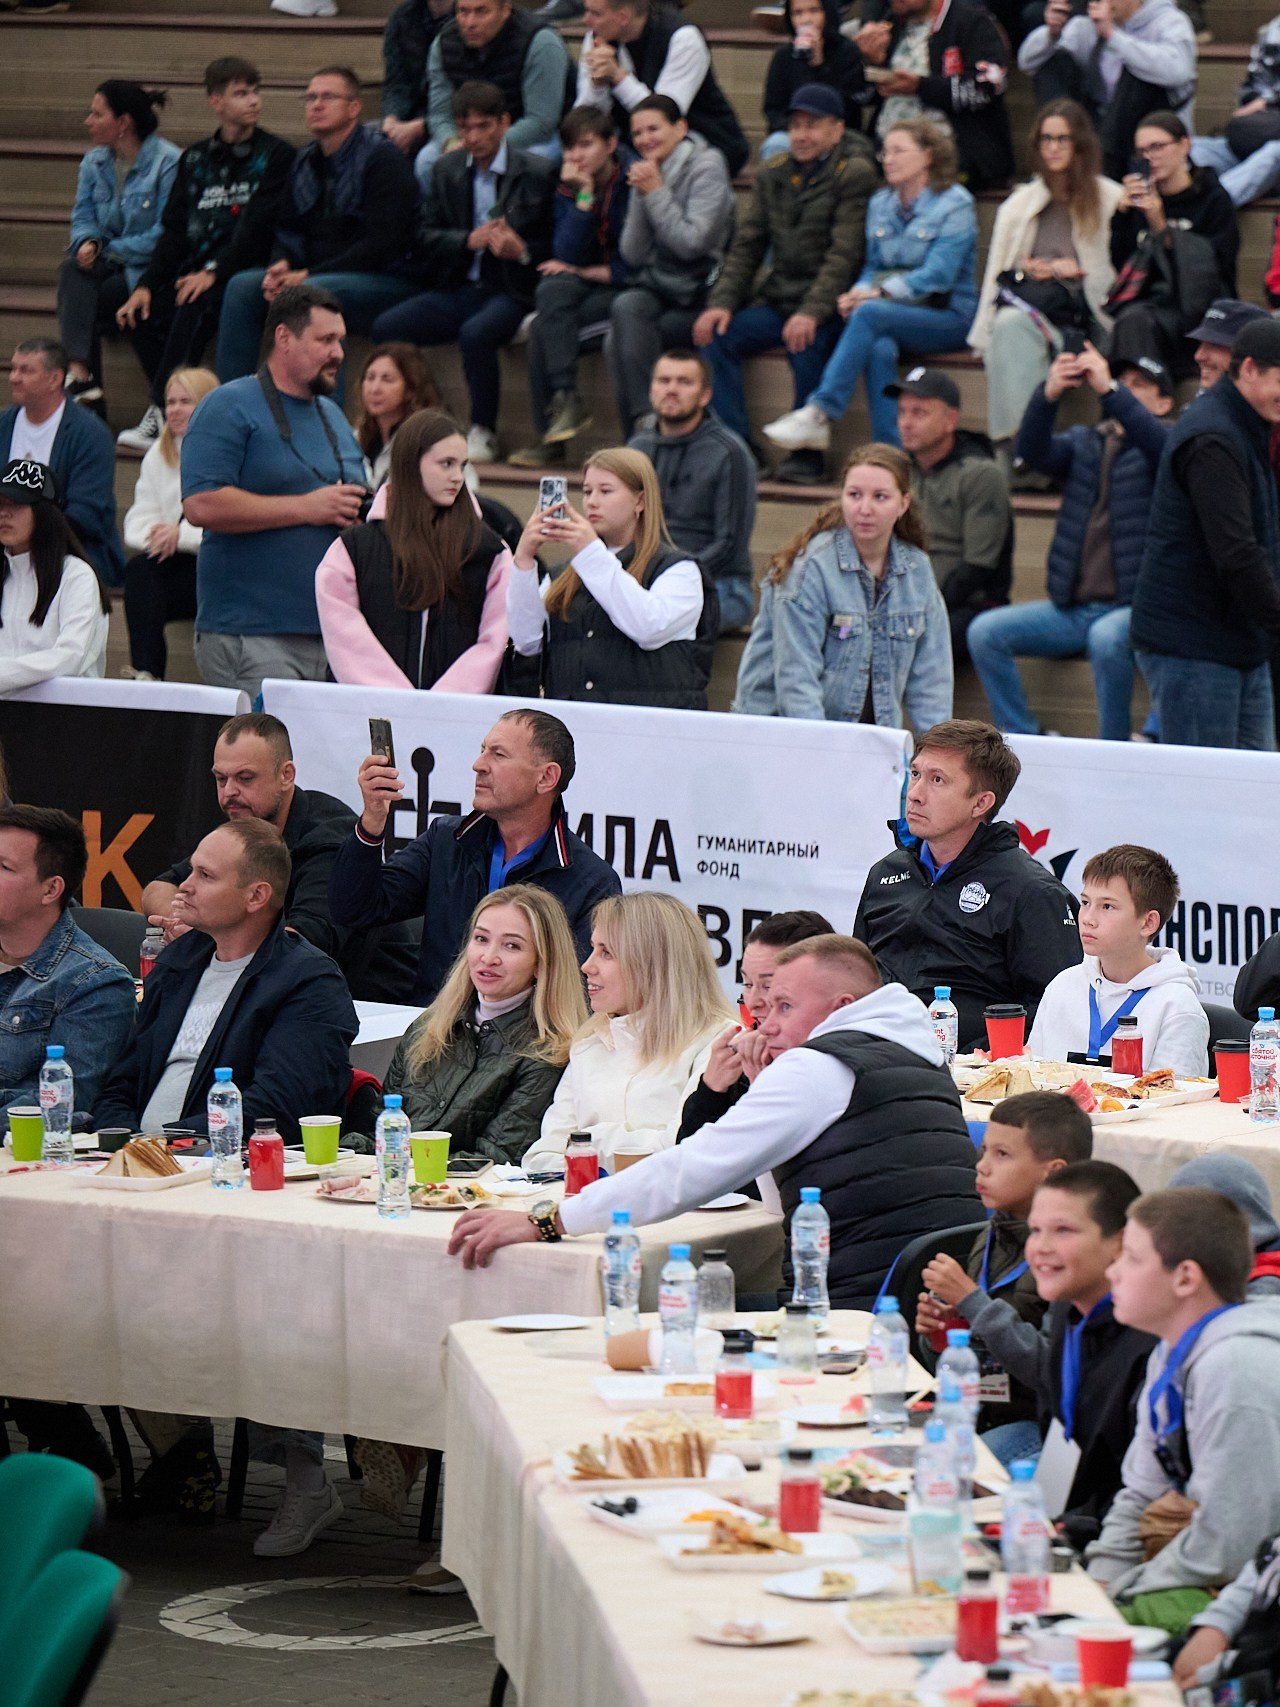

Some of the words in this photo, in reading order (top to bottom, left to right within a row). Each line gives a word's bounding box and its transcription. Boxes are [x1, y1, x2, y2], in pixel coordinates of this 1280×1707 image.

[697, 834, 820, 859] ГУМАНИТАРНЫЙ
[696, 859, 741, 880] ФОНД
[879, 870, 911, 886] KELME
